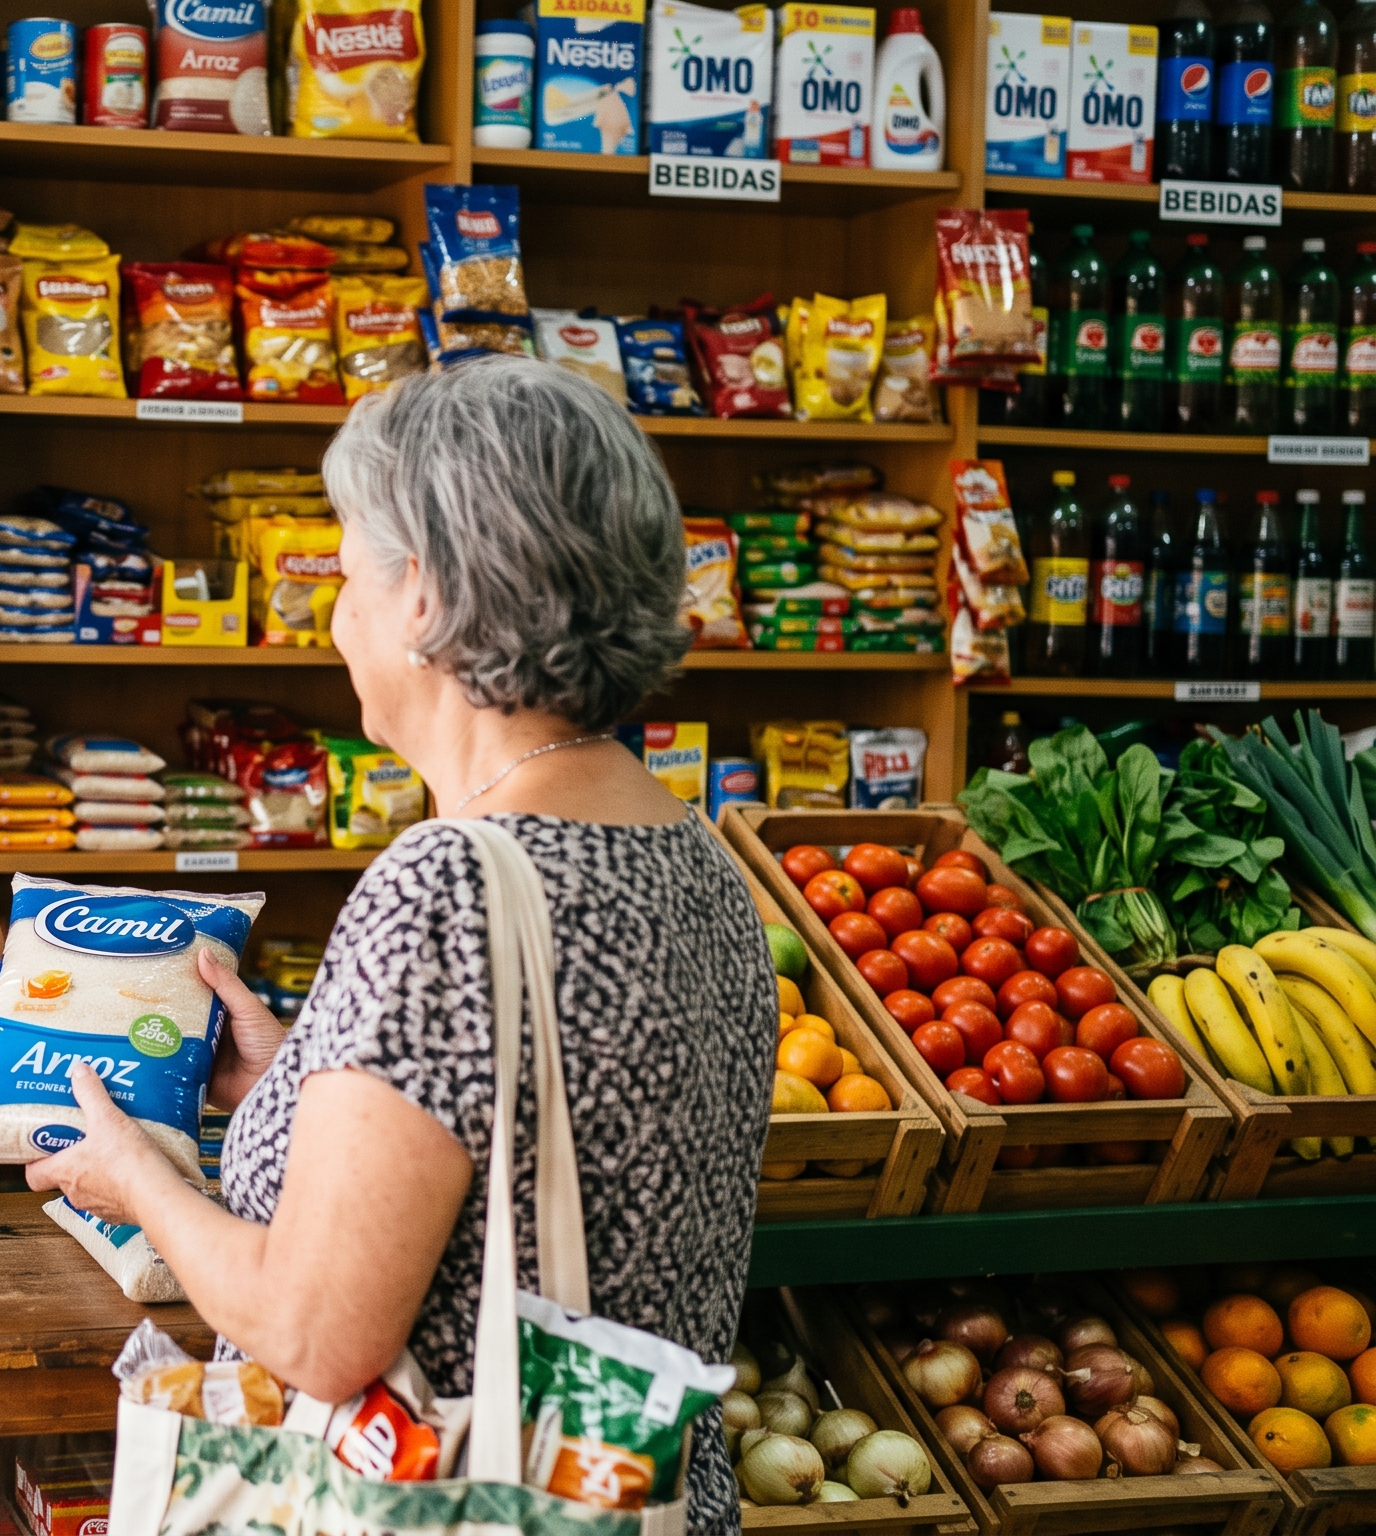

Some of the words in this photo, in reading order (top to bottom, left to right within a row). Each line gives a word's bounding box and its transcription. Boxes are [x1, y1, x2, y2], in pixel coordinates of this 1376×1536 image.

[176, 0, 254, 25] Camil
[180, 48, 241, 72] Arroz
[683, 56, 753, 94] OMO
[802, 79, 861, 114] OMO
[994, 84, 1057, 120] OMO
[1083, 91, 1144, 128] OMO
[655, 164, 776, 191] BEBIDAS
[1164, 189, 1277, 216] BEBIDAS
[54, 905, 186, 944] Camil
[10, 1041, 141, 1088] Arroz
